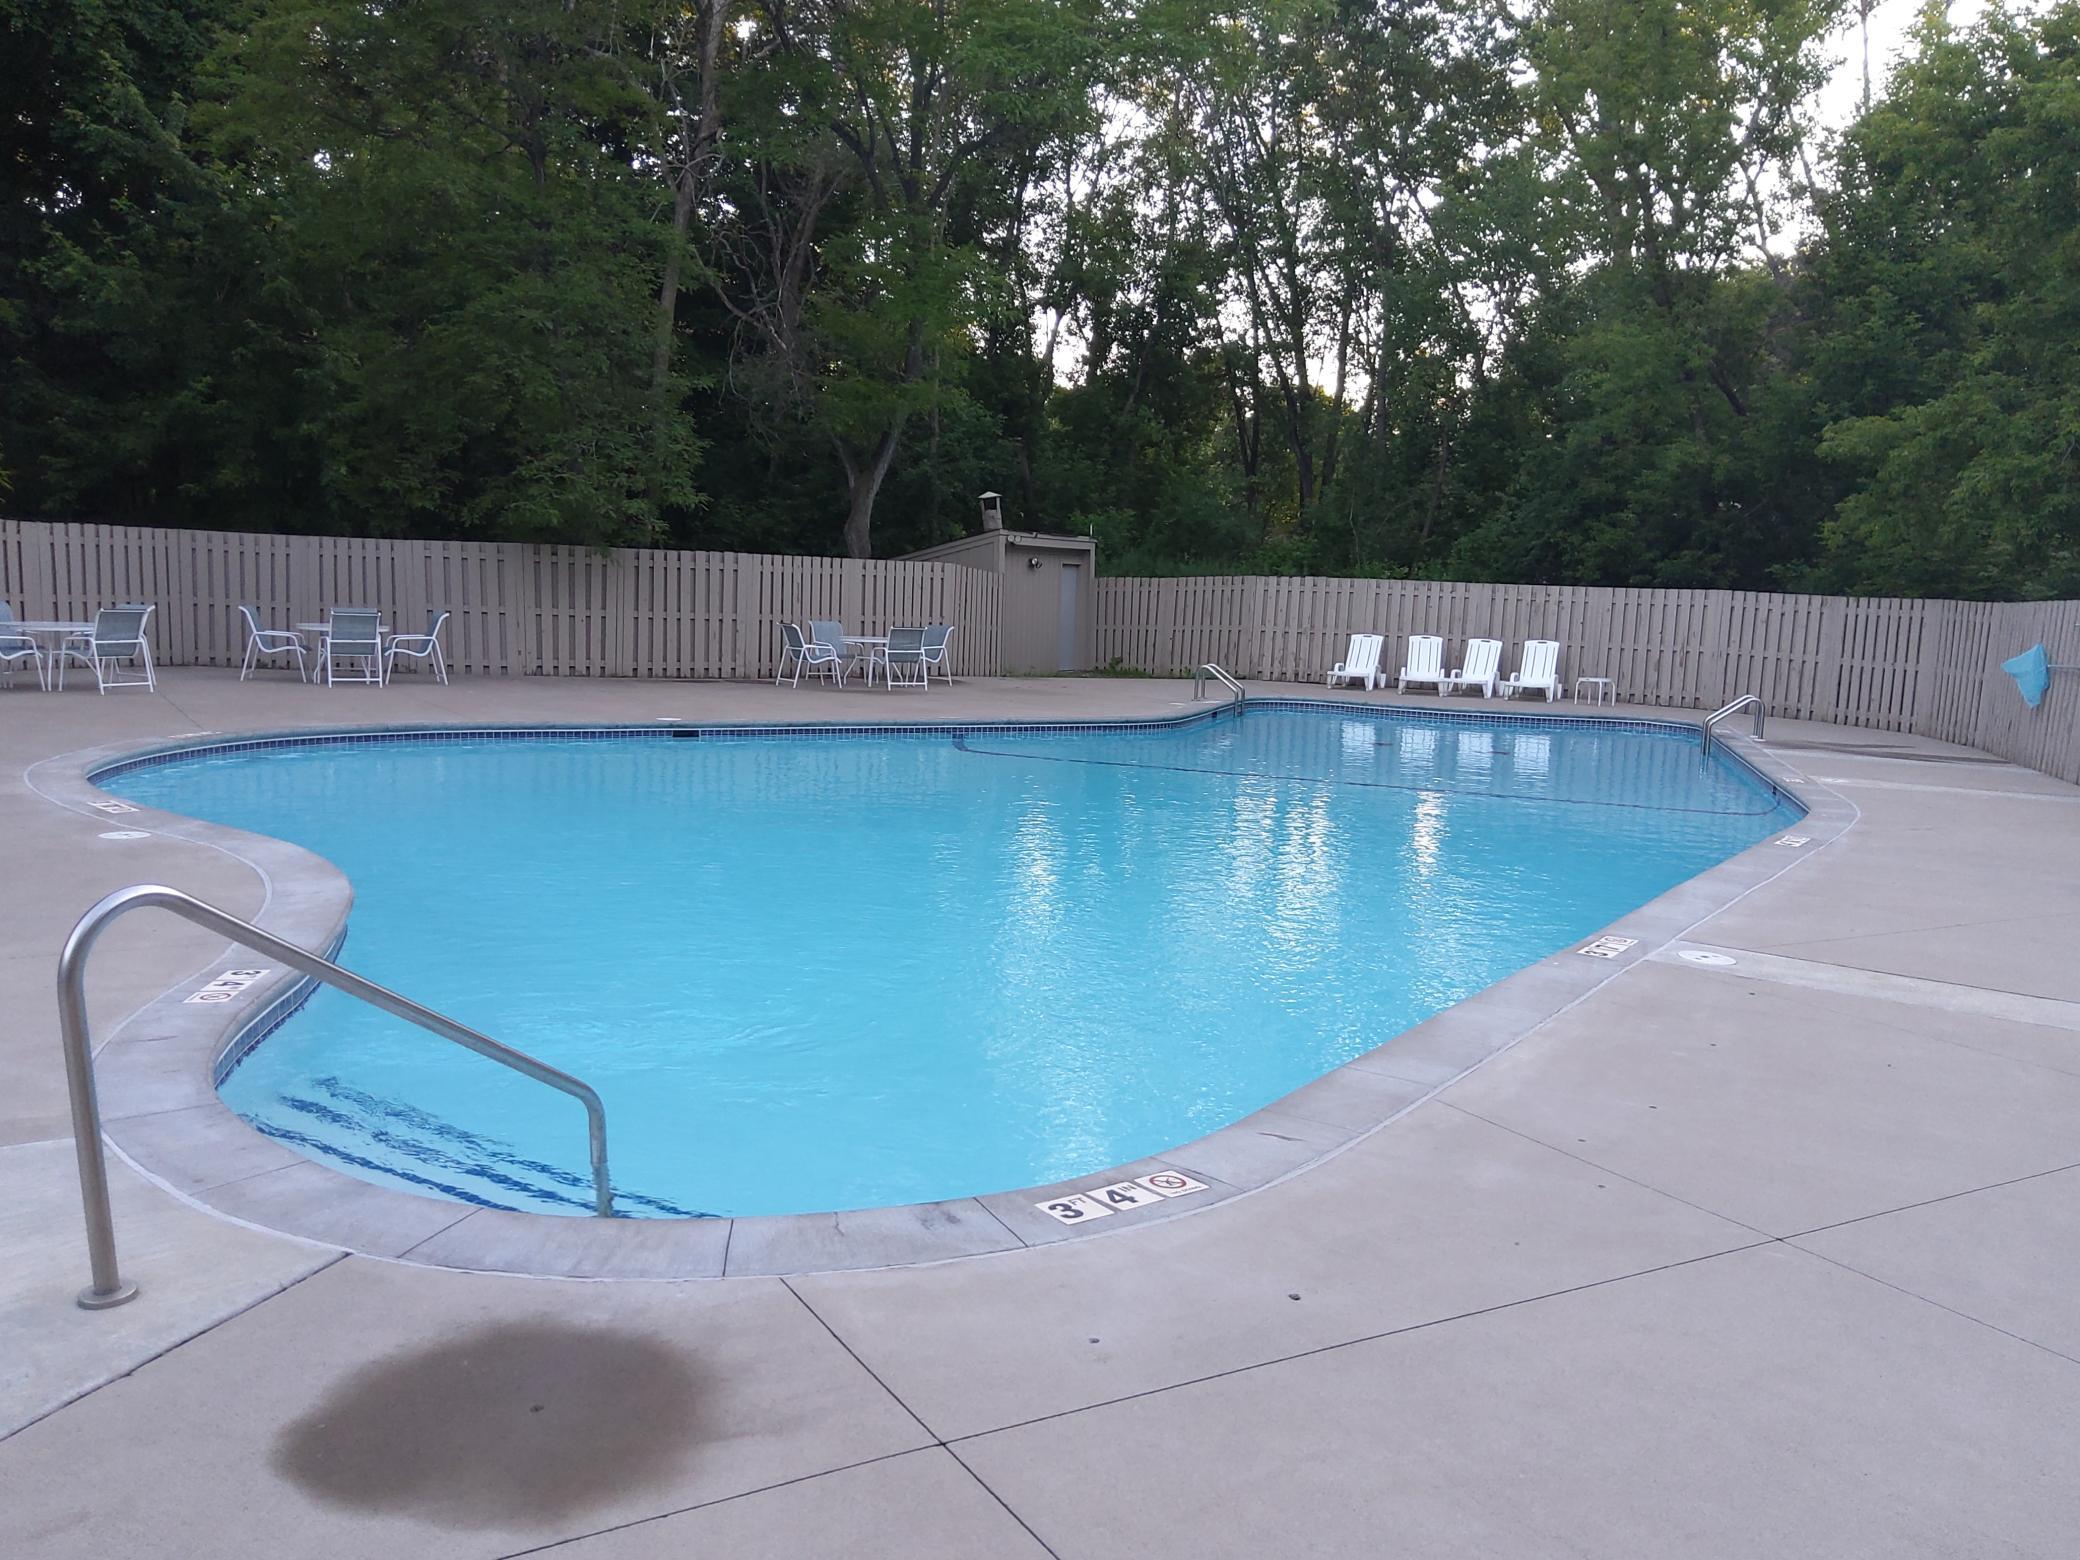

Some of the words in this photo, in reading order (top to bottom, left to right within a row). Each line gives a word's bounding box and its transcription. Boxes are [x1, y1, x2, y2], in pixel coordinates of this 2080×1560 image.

[1118, 1184, 1138, 1193] IN
[1070, 1197, 1088, 1206] FT
[1105, 1189, 1139, 1204] 4
[1048, 1202, 1084, 1219] 3
